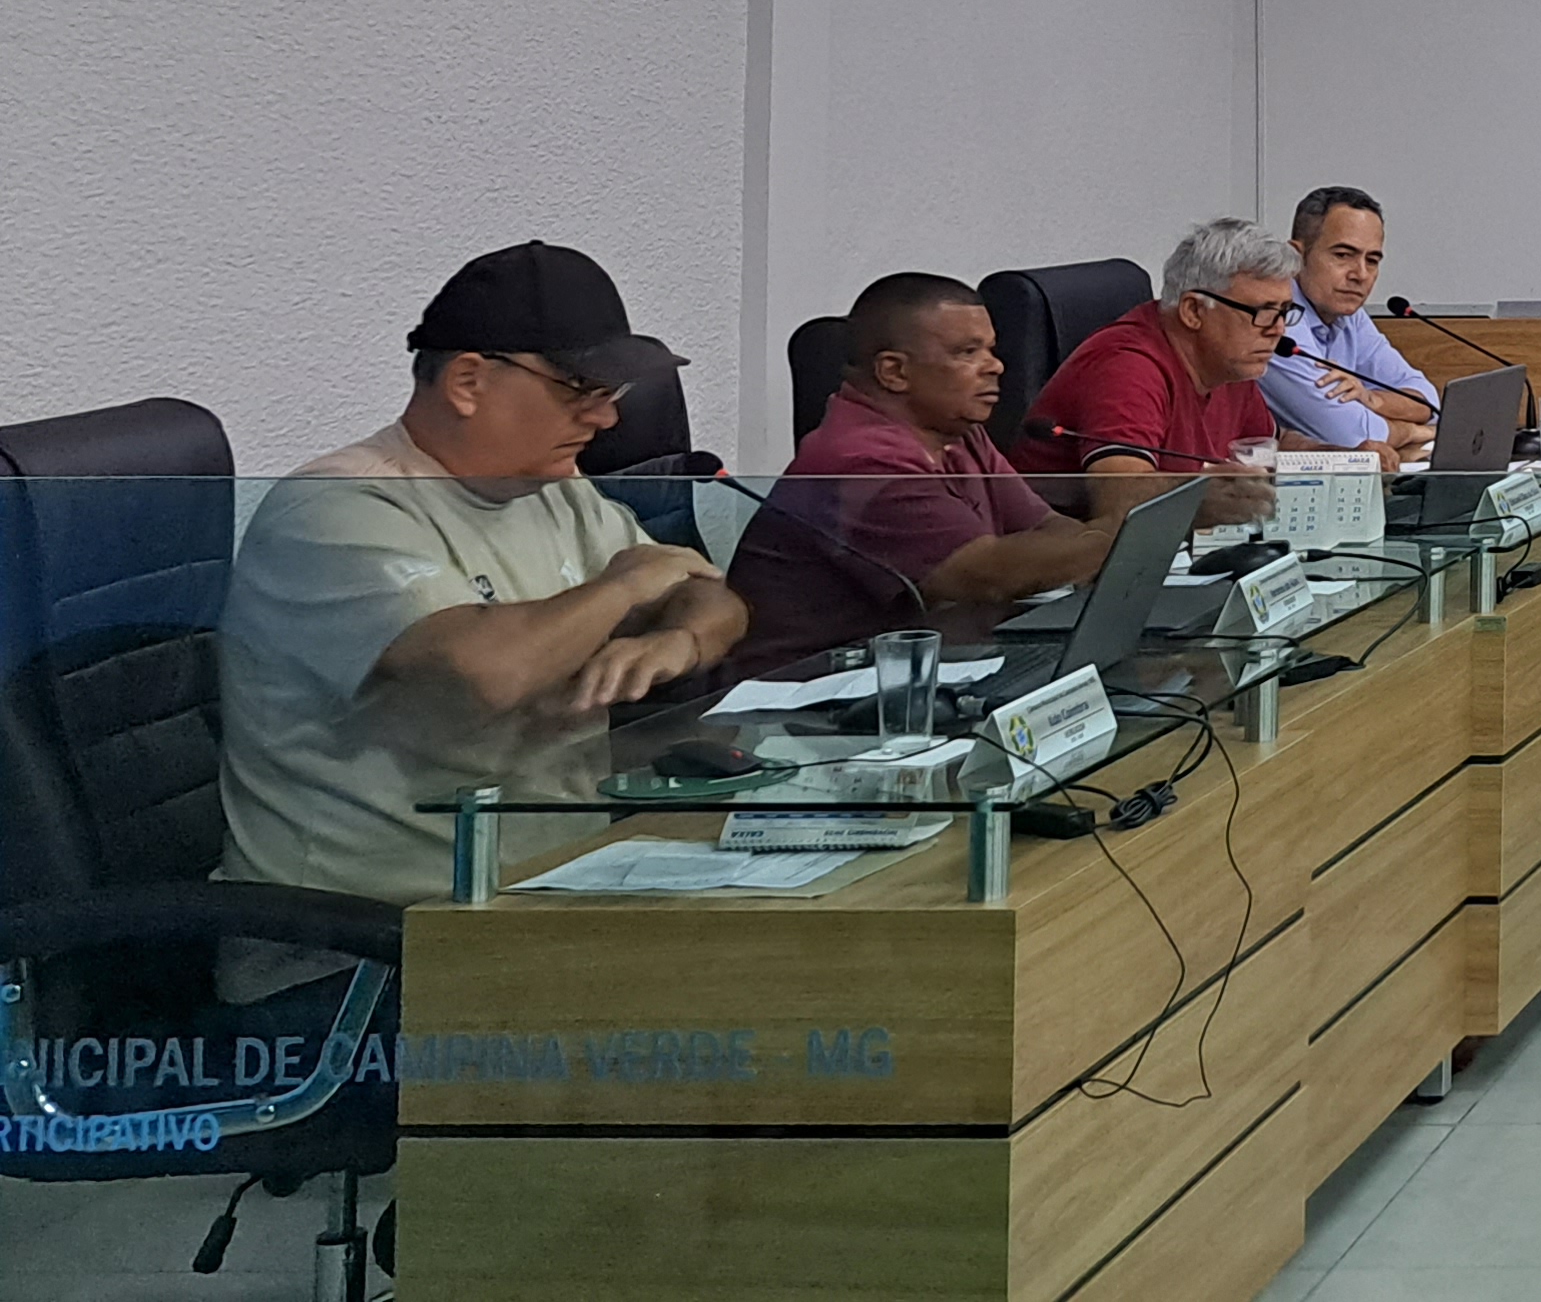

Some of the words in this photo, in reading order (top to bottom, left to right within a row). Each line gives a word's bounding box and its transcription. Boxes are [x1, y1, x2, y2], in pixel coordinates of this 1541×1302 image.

[234, 1036, 306, 1087] DE
[319, 1032, 570, 1083] CAMPINA
[585, 1028, 758, 1082] VERDE
[806, 1026, 894, 1078] MG
